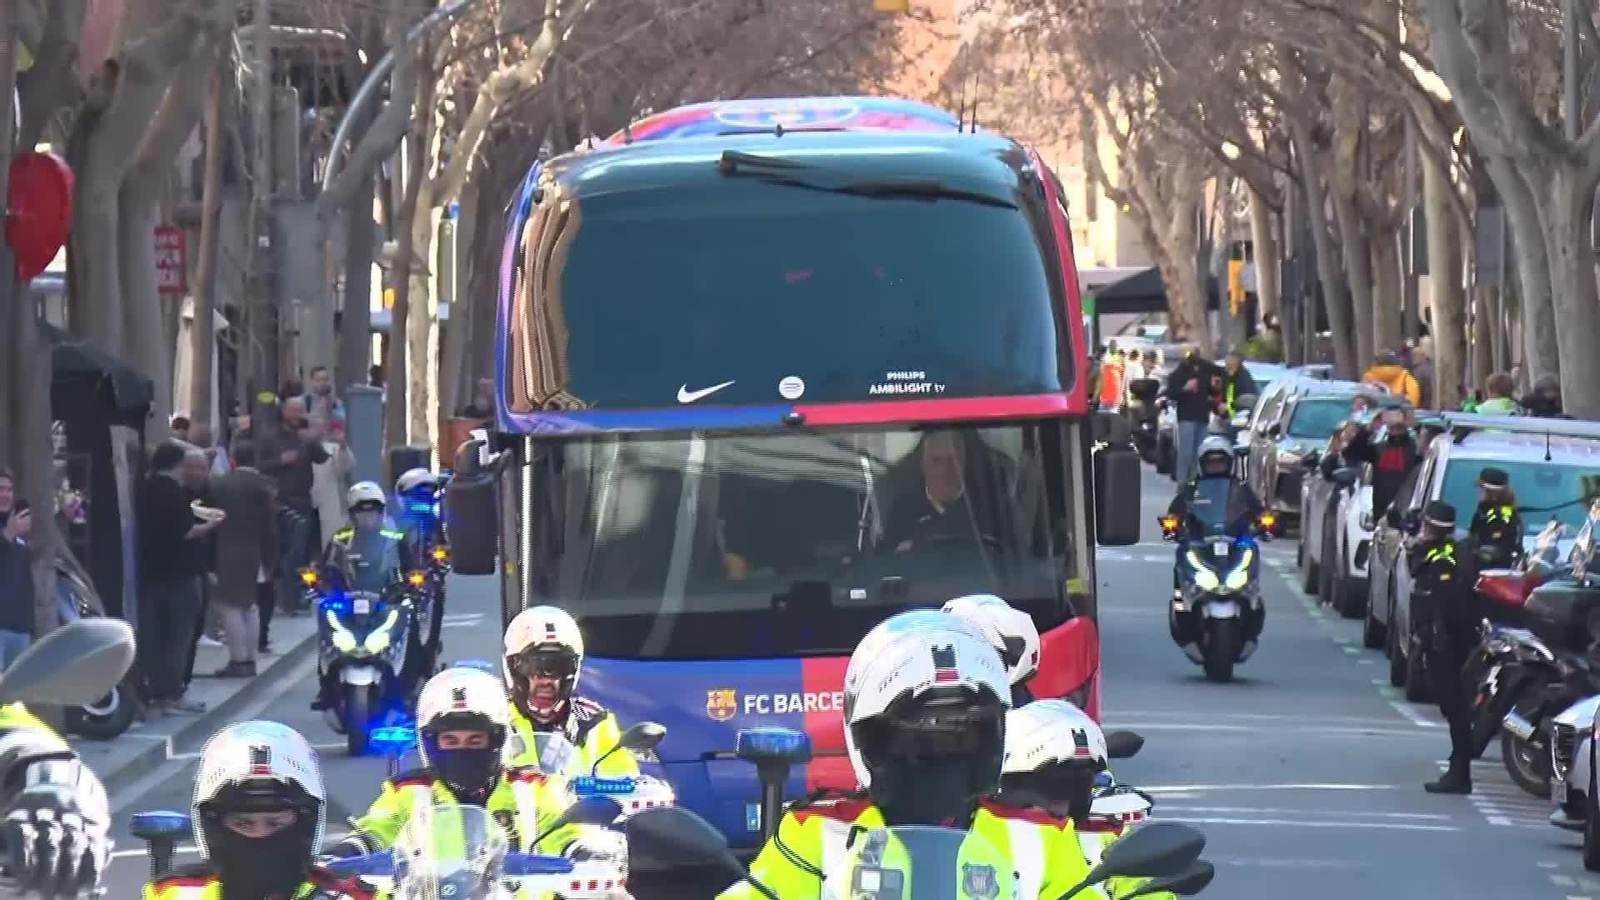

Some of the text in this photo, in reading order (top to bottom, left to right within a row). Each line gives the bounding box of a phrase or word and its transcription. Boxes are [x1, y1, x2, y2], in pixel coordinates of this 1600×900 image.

[886, 371, 926, 380] PHILIPS
[869, 382, 932, 394] AMBILIGHT
[744, 694, 770, 714] FC
[774, 692, 844, 713] BARCE
